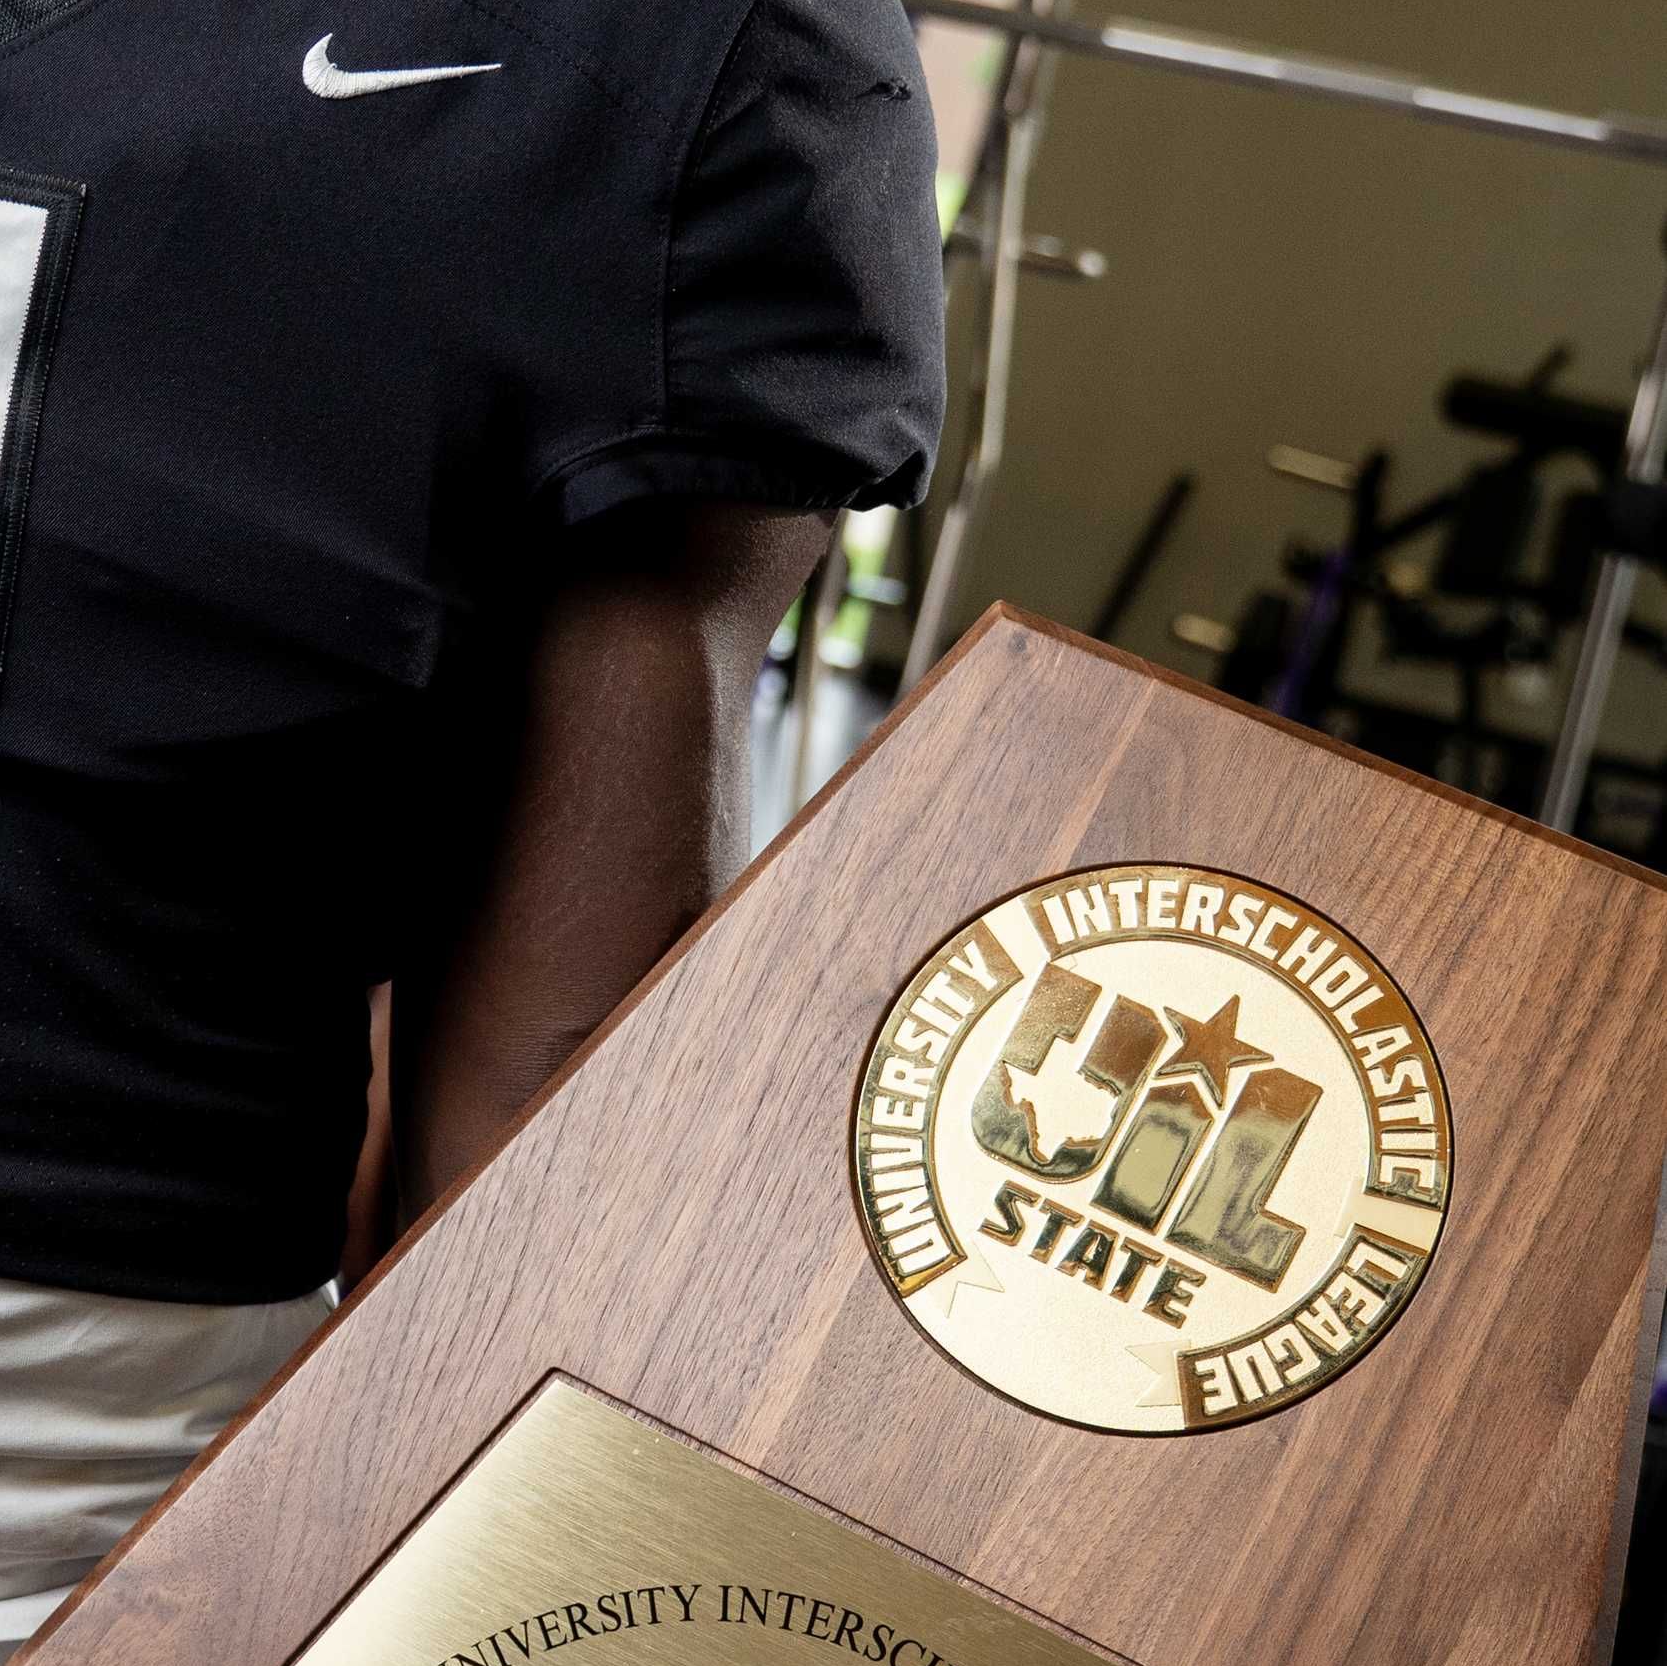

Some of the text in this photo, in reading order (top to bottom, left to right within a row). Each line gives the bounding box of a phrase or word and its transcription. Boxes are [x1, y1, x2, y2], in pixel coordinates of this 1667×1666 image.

[869, 878, 1436, 1415] UNIVERSITY INTERSCHOLASTIC LEAGUE
[977, 1179, 1207, 1329] STATE
